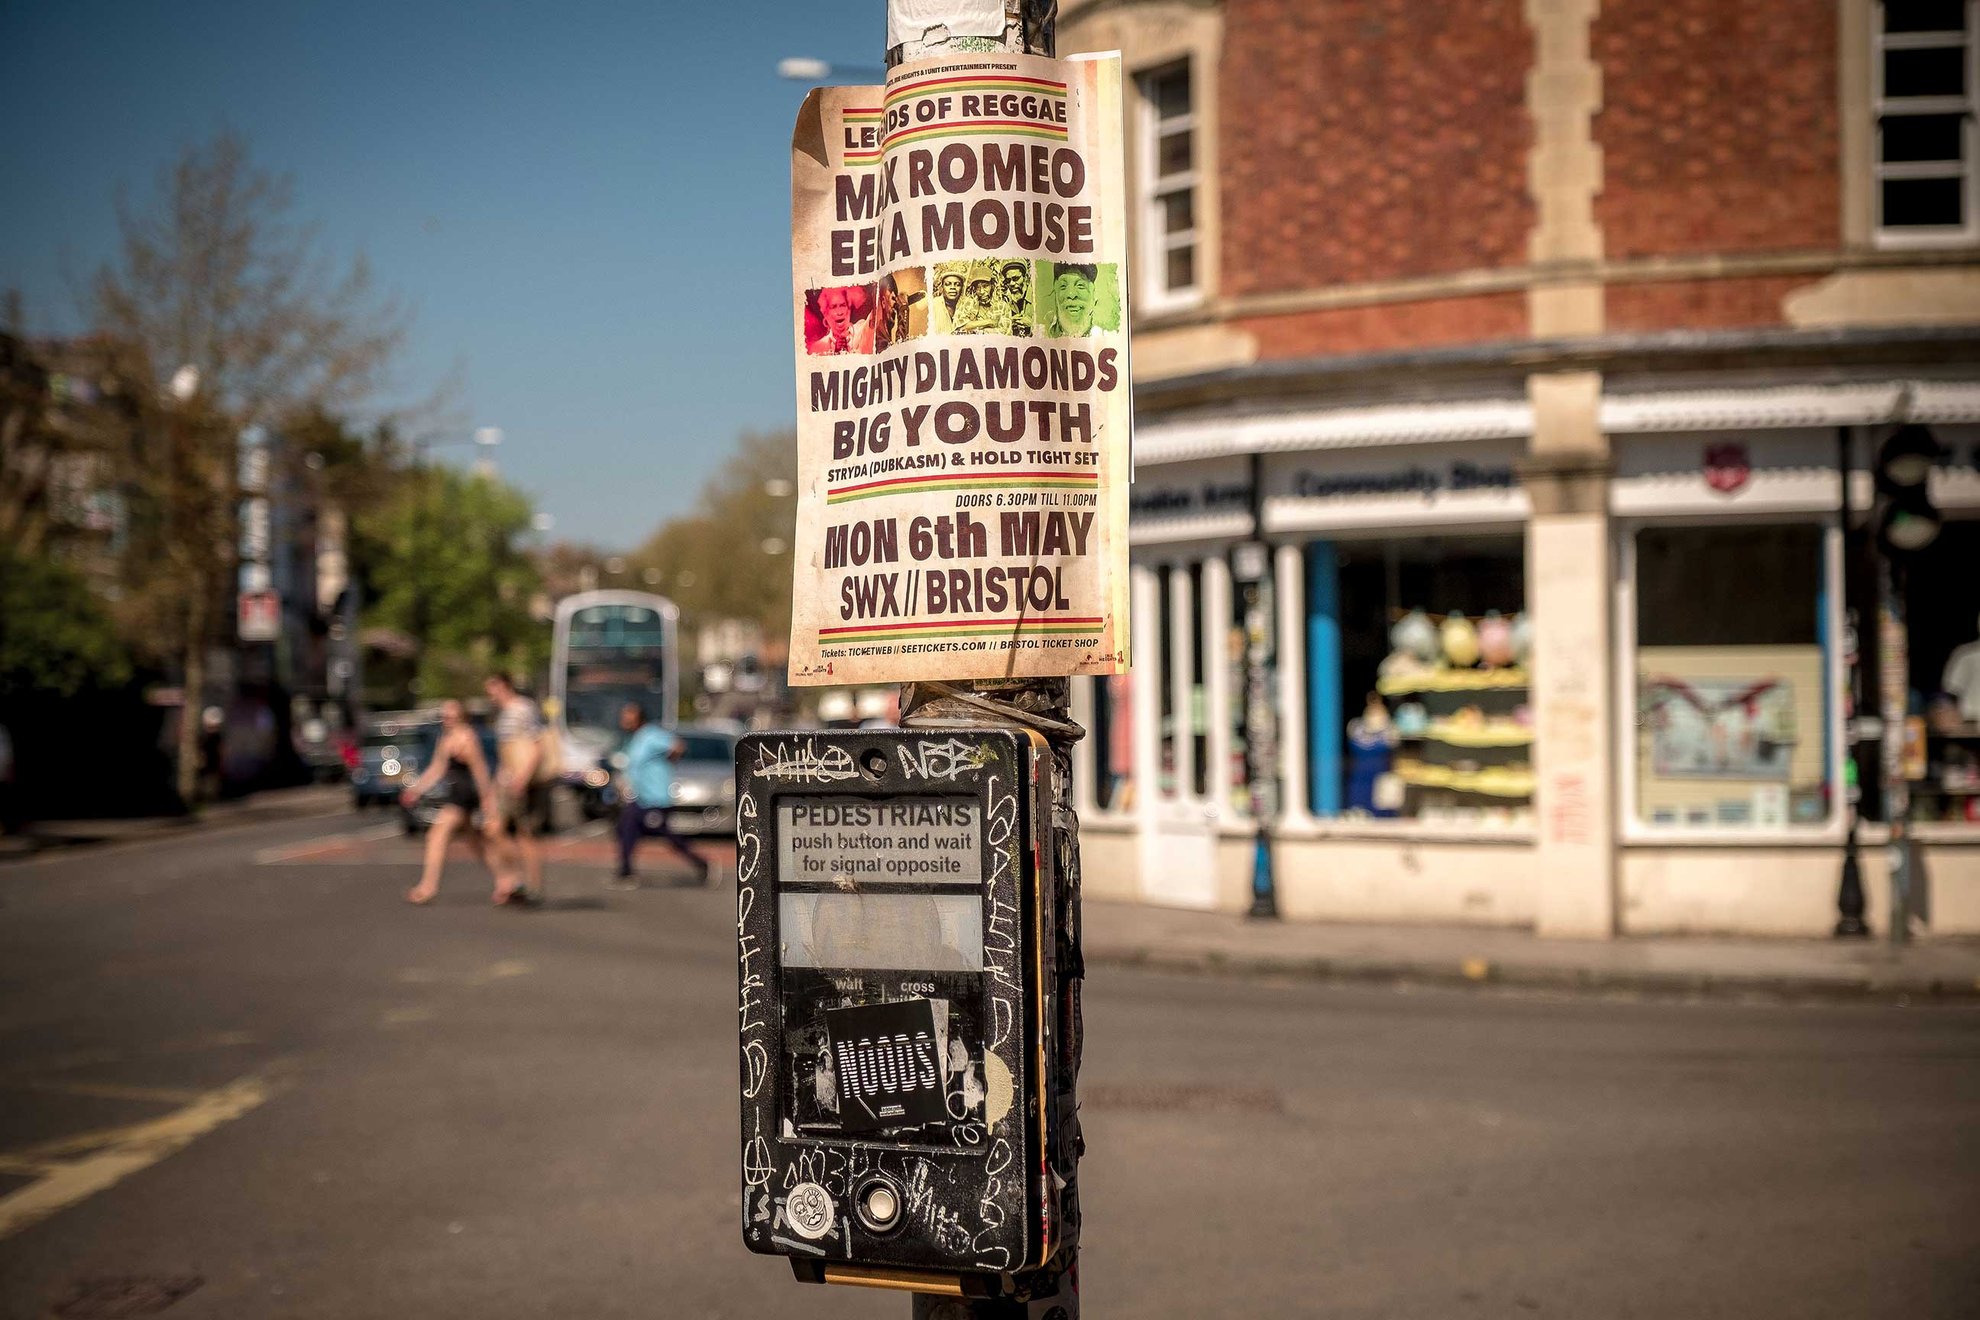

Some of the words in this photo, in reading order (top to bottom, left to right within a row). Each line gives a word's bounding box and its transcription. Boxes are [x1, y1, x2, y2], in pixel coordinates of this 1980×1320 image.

[941, 63, 991, 73] ENTERTAINMENT
[991, 63, 1018, 71] PRESENT
[915, 97, 952, 123] OF
[962, 94, 1067, 124] REGGAE
[909, 142, 1086, 199] ROMEO
[922, 198, 1094, 254] MOUSE
[810, 354, 909, 412] MIGHTY
[914, 345, 1118, 394] DIAMONDS
[833, 411, 892, 461] BIG
[900, 400, 1092, 447] YOUTH
[827, 460, 869, 483] STRYDA
[869, 452, 947, 477] (DUBKASM)
[951, 453, 966, 467] &
[971, 451, 1022, 466] HOLD
[1026, 450, 1072, 466] TIGHT
[1074, 450, 1099, 466] SET
[955, 493, 993, 508] DOORS
[996, 492, 1038, 507] 6.30PM
[1040, 493, 1060, 506] TILL
[1062, 493, 1098, 507] 11.00PM
[823, 517, 899, 570] MON
[908, 511, 988, 561] 6th
[1000, 511, 1095, 557] MAY
[840, 572, 901, 621] SWX
[926, 565, 1070, 616] BRISTOL
[821, 649, 848, 659] Tickets:
[848, 645, 893, 657] TICKETWEB
[901, 641, 986, 654] SEETICKETS.COM
[1000, 640, 1040, 650] BRISTOL
[1042, 639, 1073, 649] TICKET
[1074, 638, 1099, 648] SHOP
[791, 803, 972, 827] PEDESTRIANS
[792, 833, 832, 852] push
[838, 832, 893, 850] button
[898, 833, 929, 850] and
[934, 832, 972, 850] wait
[803, 855, 826, 872] for
[830, 855, 881, 875] signal
[886, 856, 961, 876] opposite
[900, 981, 936, 993] cross
[837, 1031, 936, 1099] NOODS
